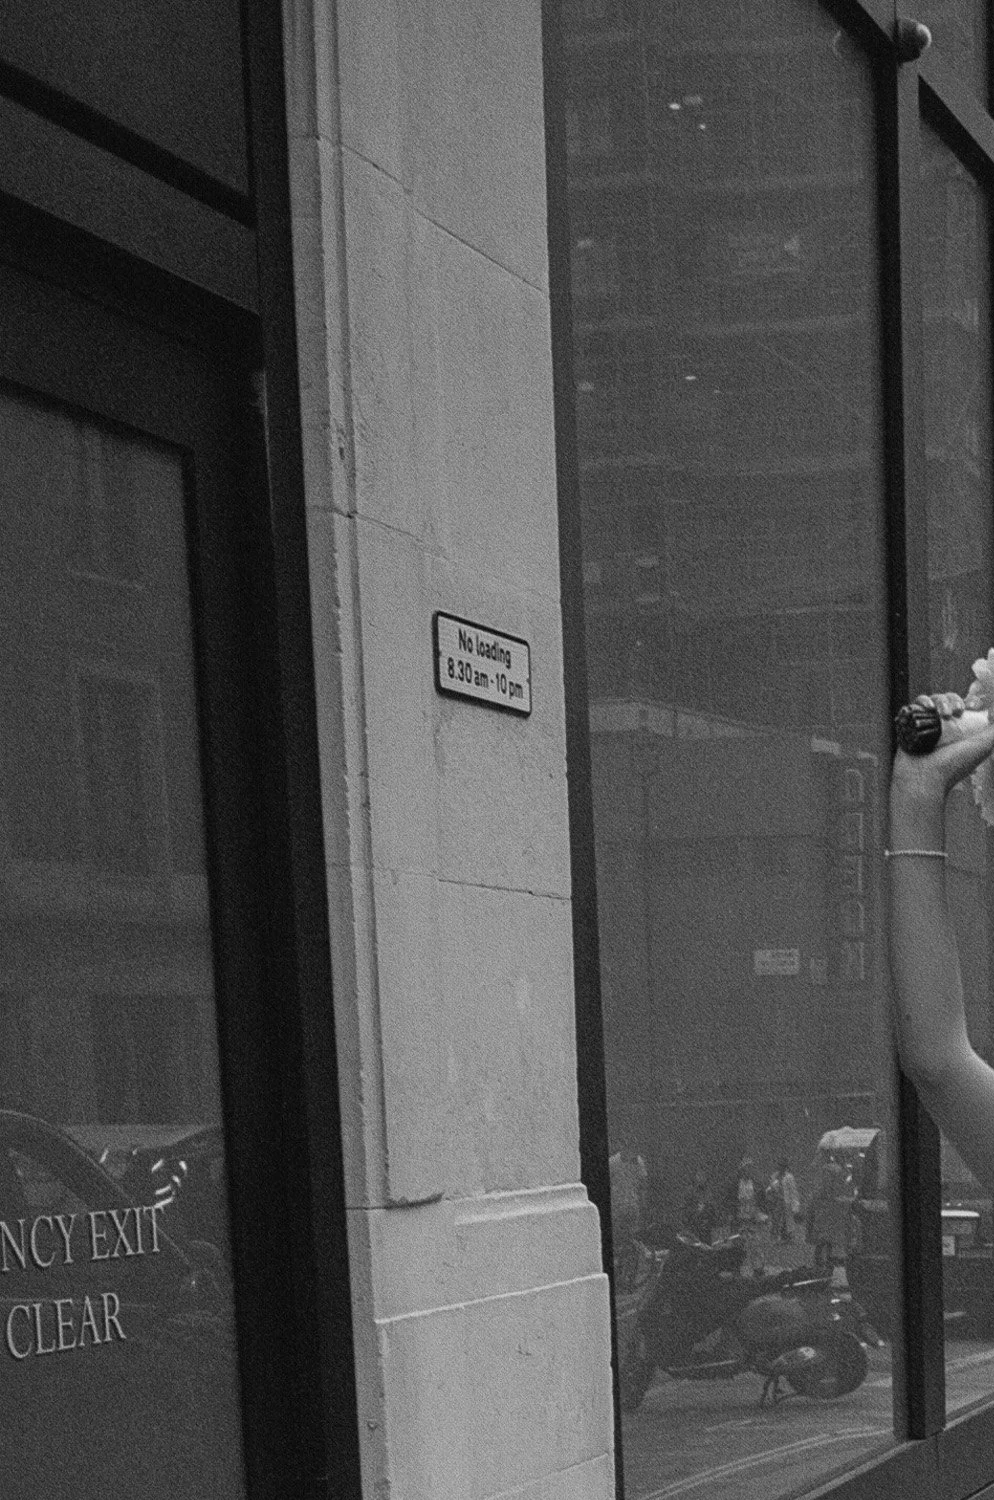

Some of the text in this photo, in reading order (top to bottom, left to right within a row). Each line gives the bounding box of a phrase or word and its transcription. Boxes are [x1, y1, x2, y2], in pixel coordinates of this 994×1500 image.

[458, 628, 512, 670] No loading
[88, 1206, 166, 1261] EXIT
[6, 1292, 127, 1358] CLEAR
